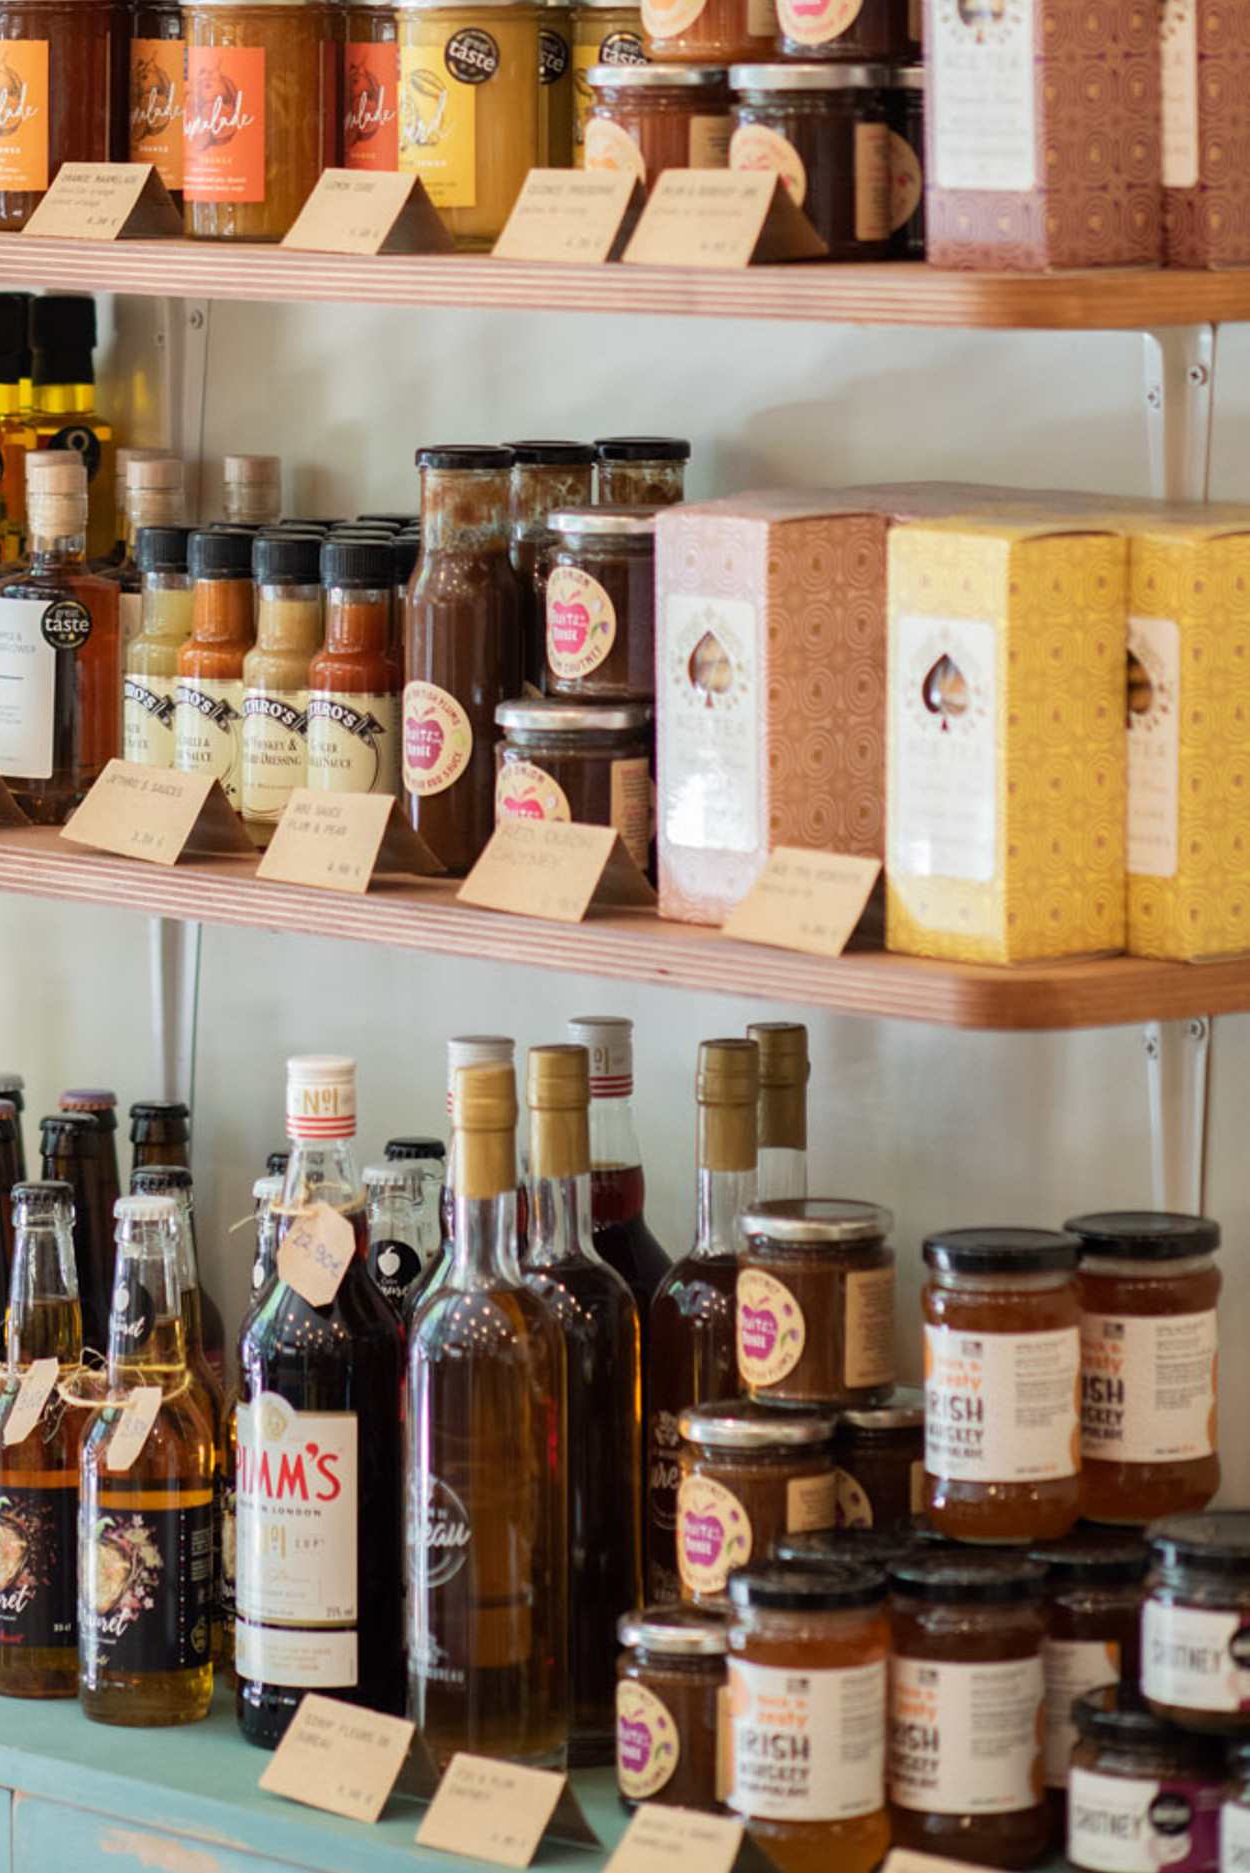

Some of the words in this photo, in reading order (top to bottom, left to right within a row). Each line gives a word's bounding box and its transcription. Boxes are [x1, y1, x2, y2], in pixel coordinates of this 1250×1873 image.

[448, 47, 496, 73] taste
[55, 607, 80, 619] great
[45, 617, 91, 634] taste
[1082, 1375, 1125, 1404] ISH
[236, 1442, 342, 1503] PIMM'S
[271, 1507, 323, 1519] LONDON
[295, 1538, 320, 1550] CUP
